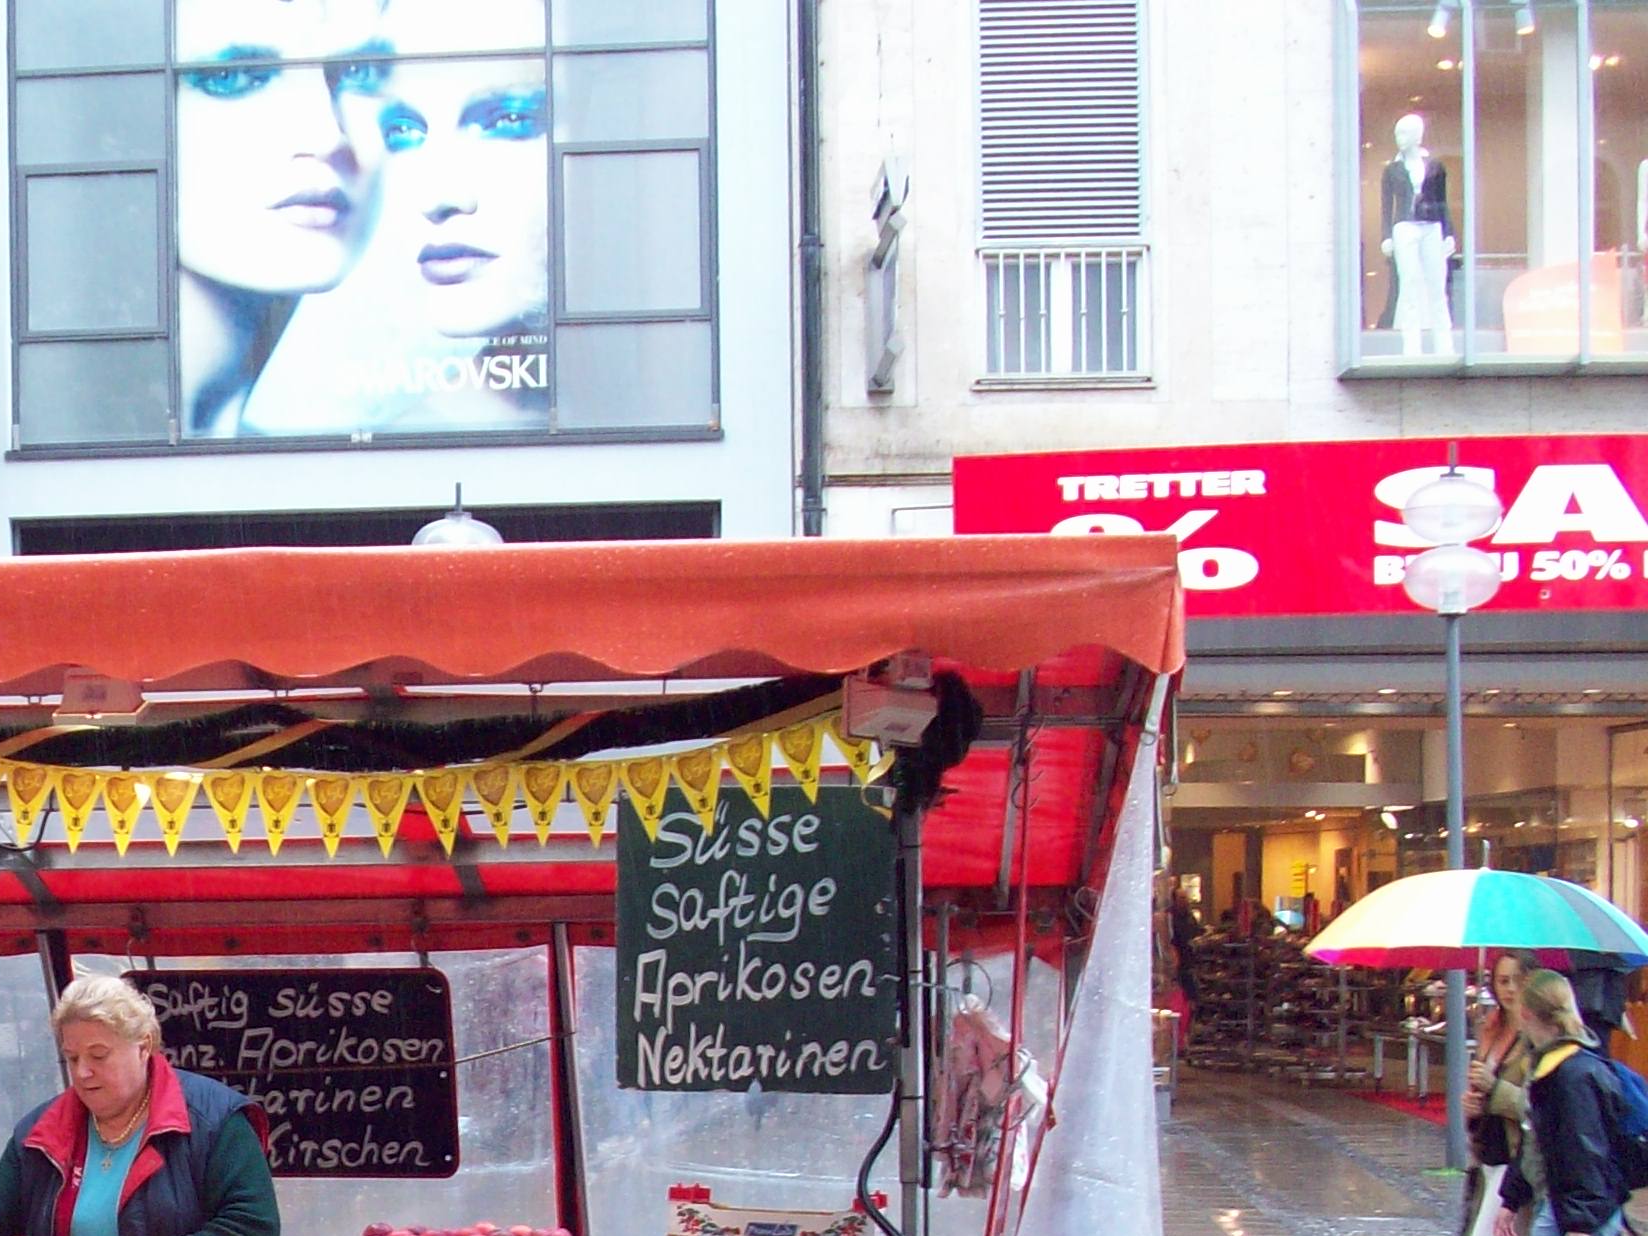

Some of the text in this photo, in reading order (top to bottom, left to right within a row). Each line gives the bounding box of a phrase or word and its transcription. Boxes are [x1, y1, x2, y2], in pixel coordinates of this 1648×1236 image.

[1057, 469, 1266, 501] TRETTER
[1530, 549, 1632, 580] 50%
[649, 800, 822, 868] Süsse
[634, 939, 877, 1034] Aprikosen
[237, 1026, 444, 1082] Aprikosen
[637, 1022, 887, 1088] Nektarinen
